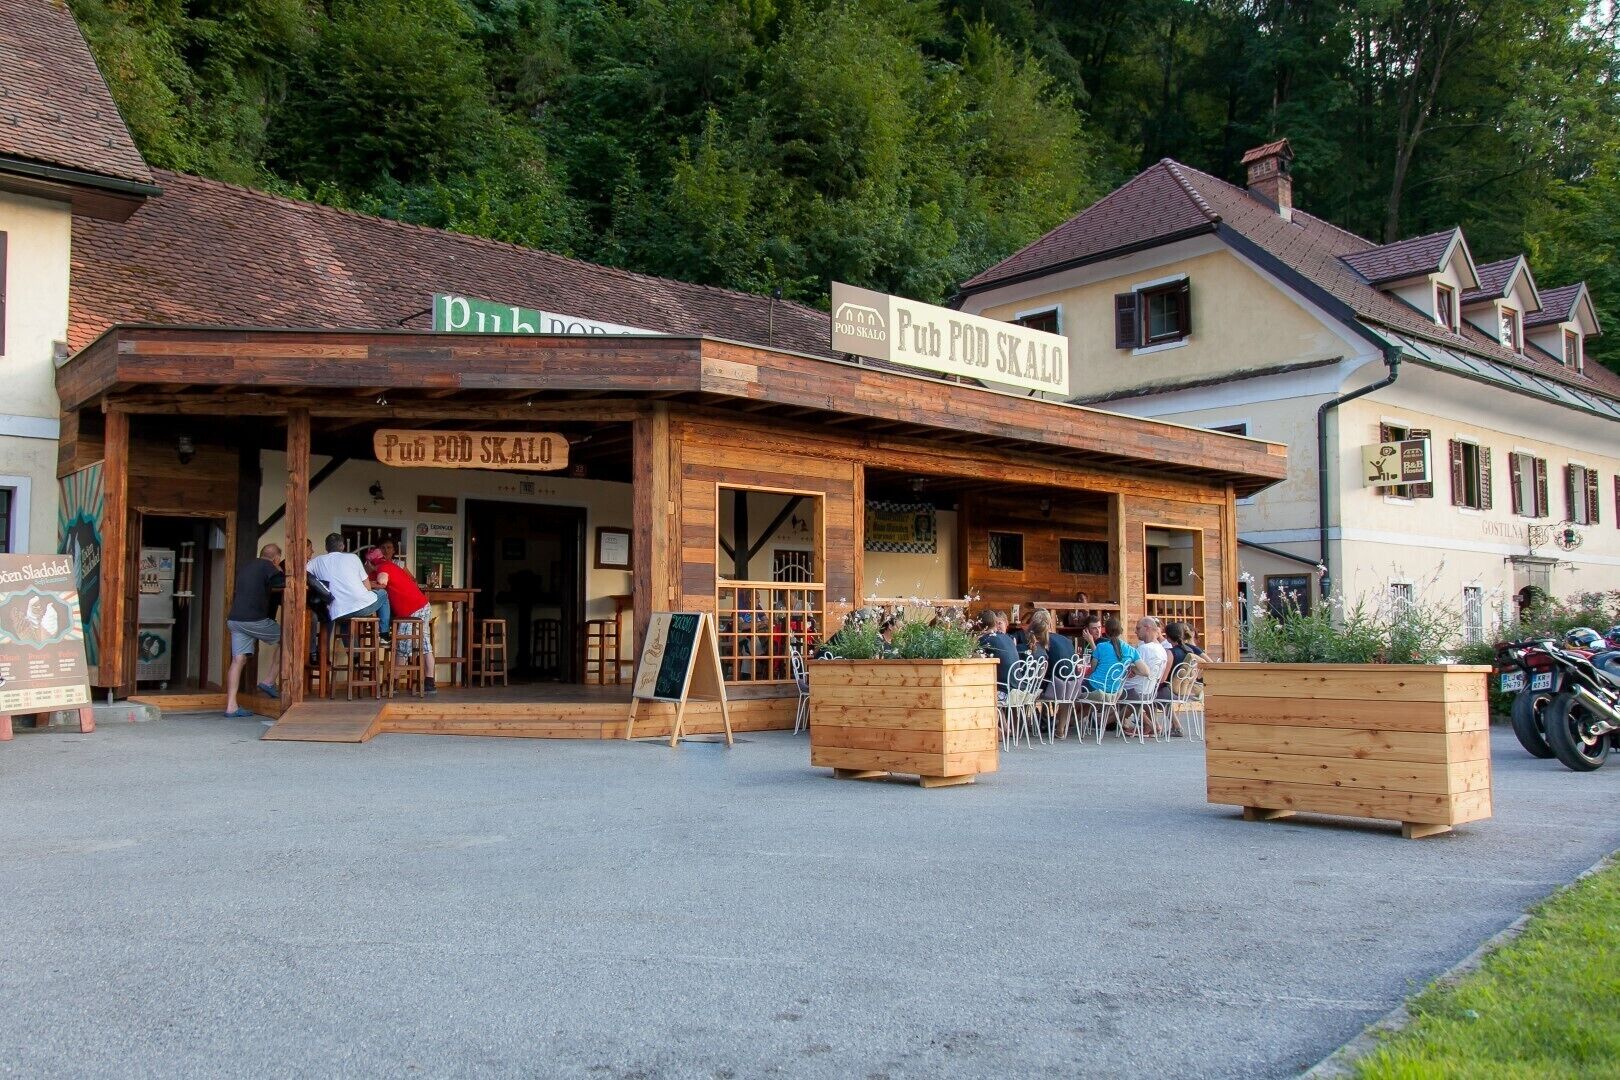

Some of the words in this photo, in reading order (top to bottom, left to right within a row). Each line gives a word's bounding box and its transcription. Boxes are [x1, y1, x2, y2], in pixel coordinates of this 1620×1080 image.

[834, 322, 855, 336] POD
[856, 326, 886, 341] SKALO
[897, 308, 942, 358] Pub
[949, 320, 989, 369] POD
[996, 331, 1063, 385] SKALO
[384, 434, 426, 462] Pub
[432, 435, 473, 463] POD
[480, 435, 553, 465] SKALO
[1403, 460, 1424, 469] B&B
[1481, 520, 1524, 539] GOSTILNA
[22, 559, 72, 580] Sladoled
